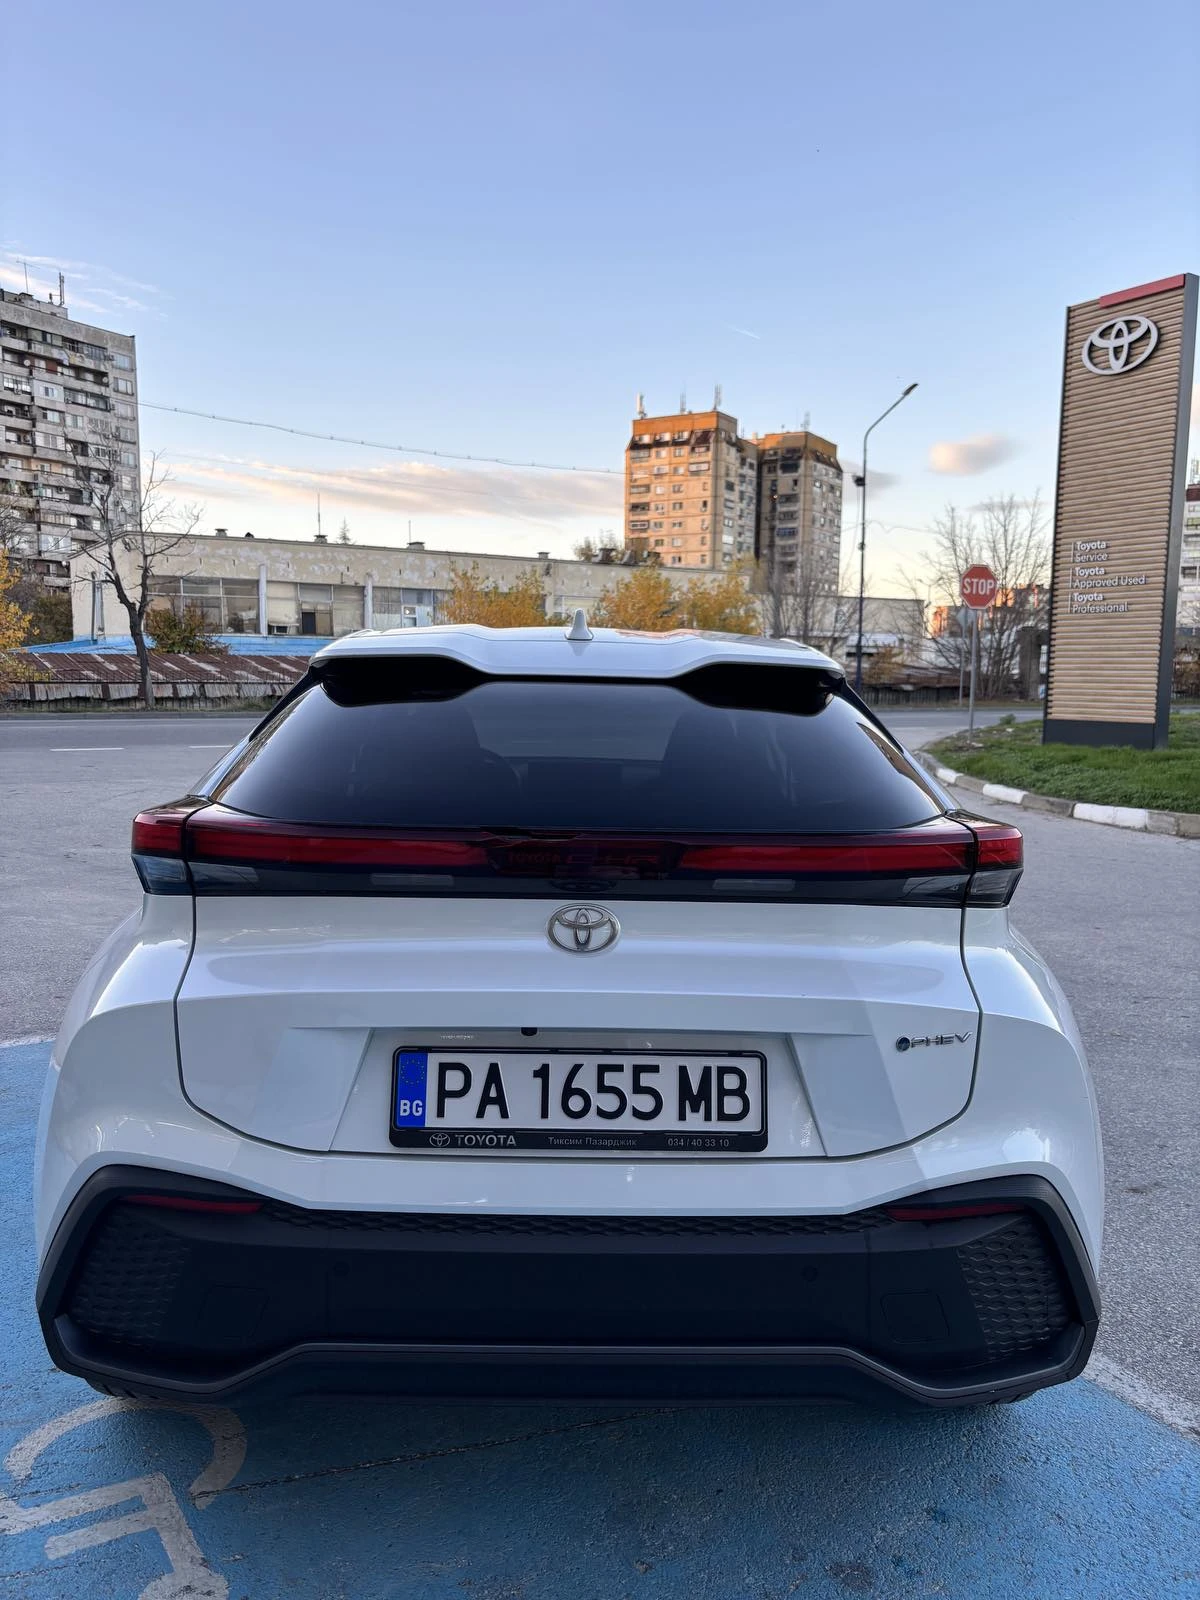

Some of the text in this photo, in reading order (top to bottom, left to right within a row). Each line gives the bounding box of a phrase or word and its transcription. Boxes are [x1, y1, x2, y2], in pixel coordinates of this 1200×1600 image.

[1076, 541, 1106, 552] Toyota
[1075, 552, 1108, 562] Service
[1074, 567, 1105, 577] Toyota
[963, 578, 994, 595] STOP
[1073, 575, 1145, 589] Approved Used
[1073, 593, 1103, 603] Toyota
[1072, 602, 1128, 613] Professional
[911, 1031, 973, 1048] PHEV
[436, 1062, 751, 1122] PA 1655 MB
[400, 1099, 423, 1116] BG
[455, 1134, 517, 1147] TOYOTA
[548, 1136, 637, 1147] Тиксим Пазарджик
[667, 1138, 684, 1146] 034
[691, 1138, 702, 1147] 40
[705, 1138, 716, 1147] 33
[719, 1138, 730, 1147] 10
